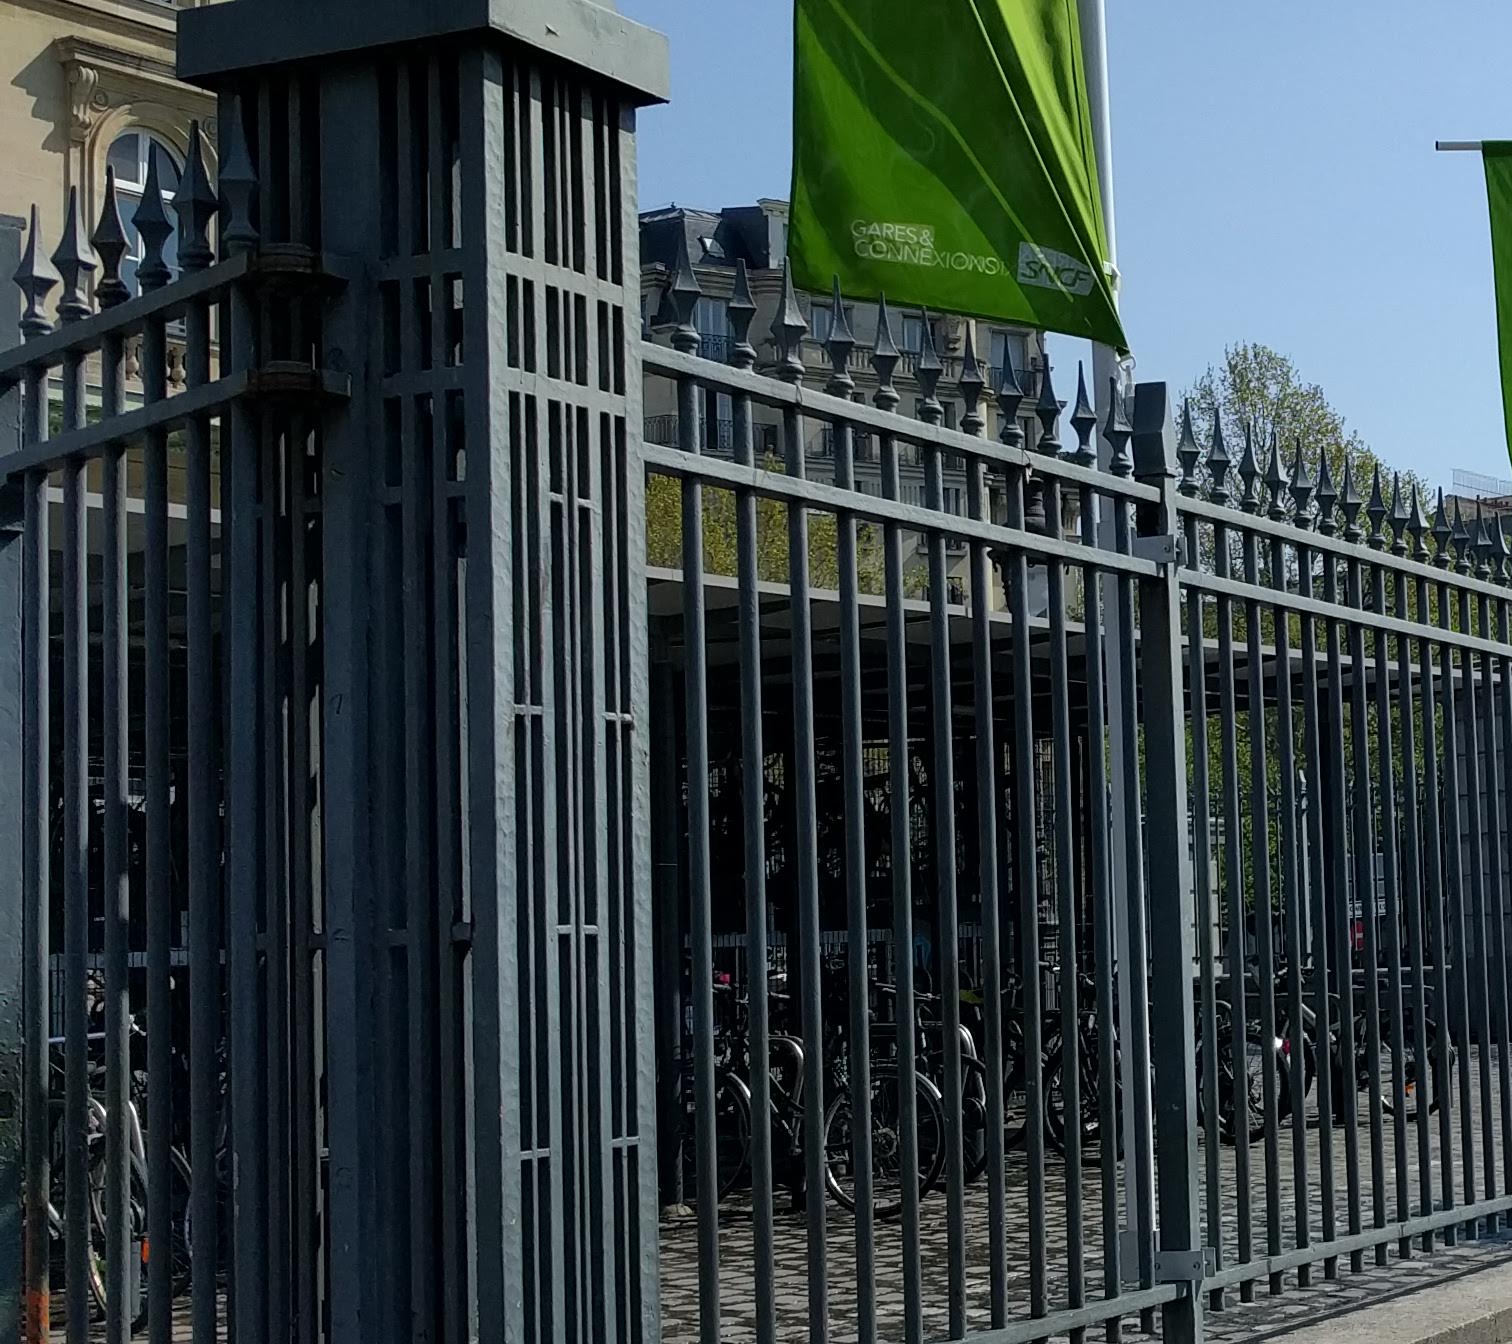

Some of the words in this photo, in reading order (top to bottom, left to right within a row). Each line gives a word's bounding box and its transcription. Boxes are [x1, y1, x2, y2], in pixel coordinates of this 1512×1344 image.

[852, 219, 917, 244] GARES
[919, 228, 935, 250] &
[855, 240, 1000, 275] CONNEXIONS
[1022, 260, 1091, 288] SNCF
